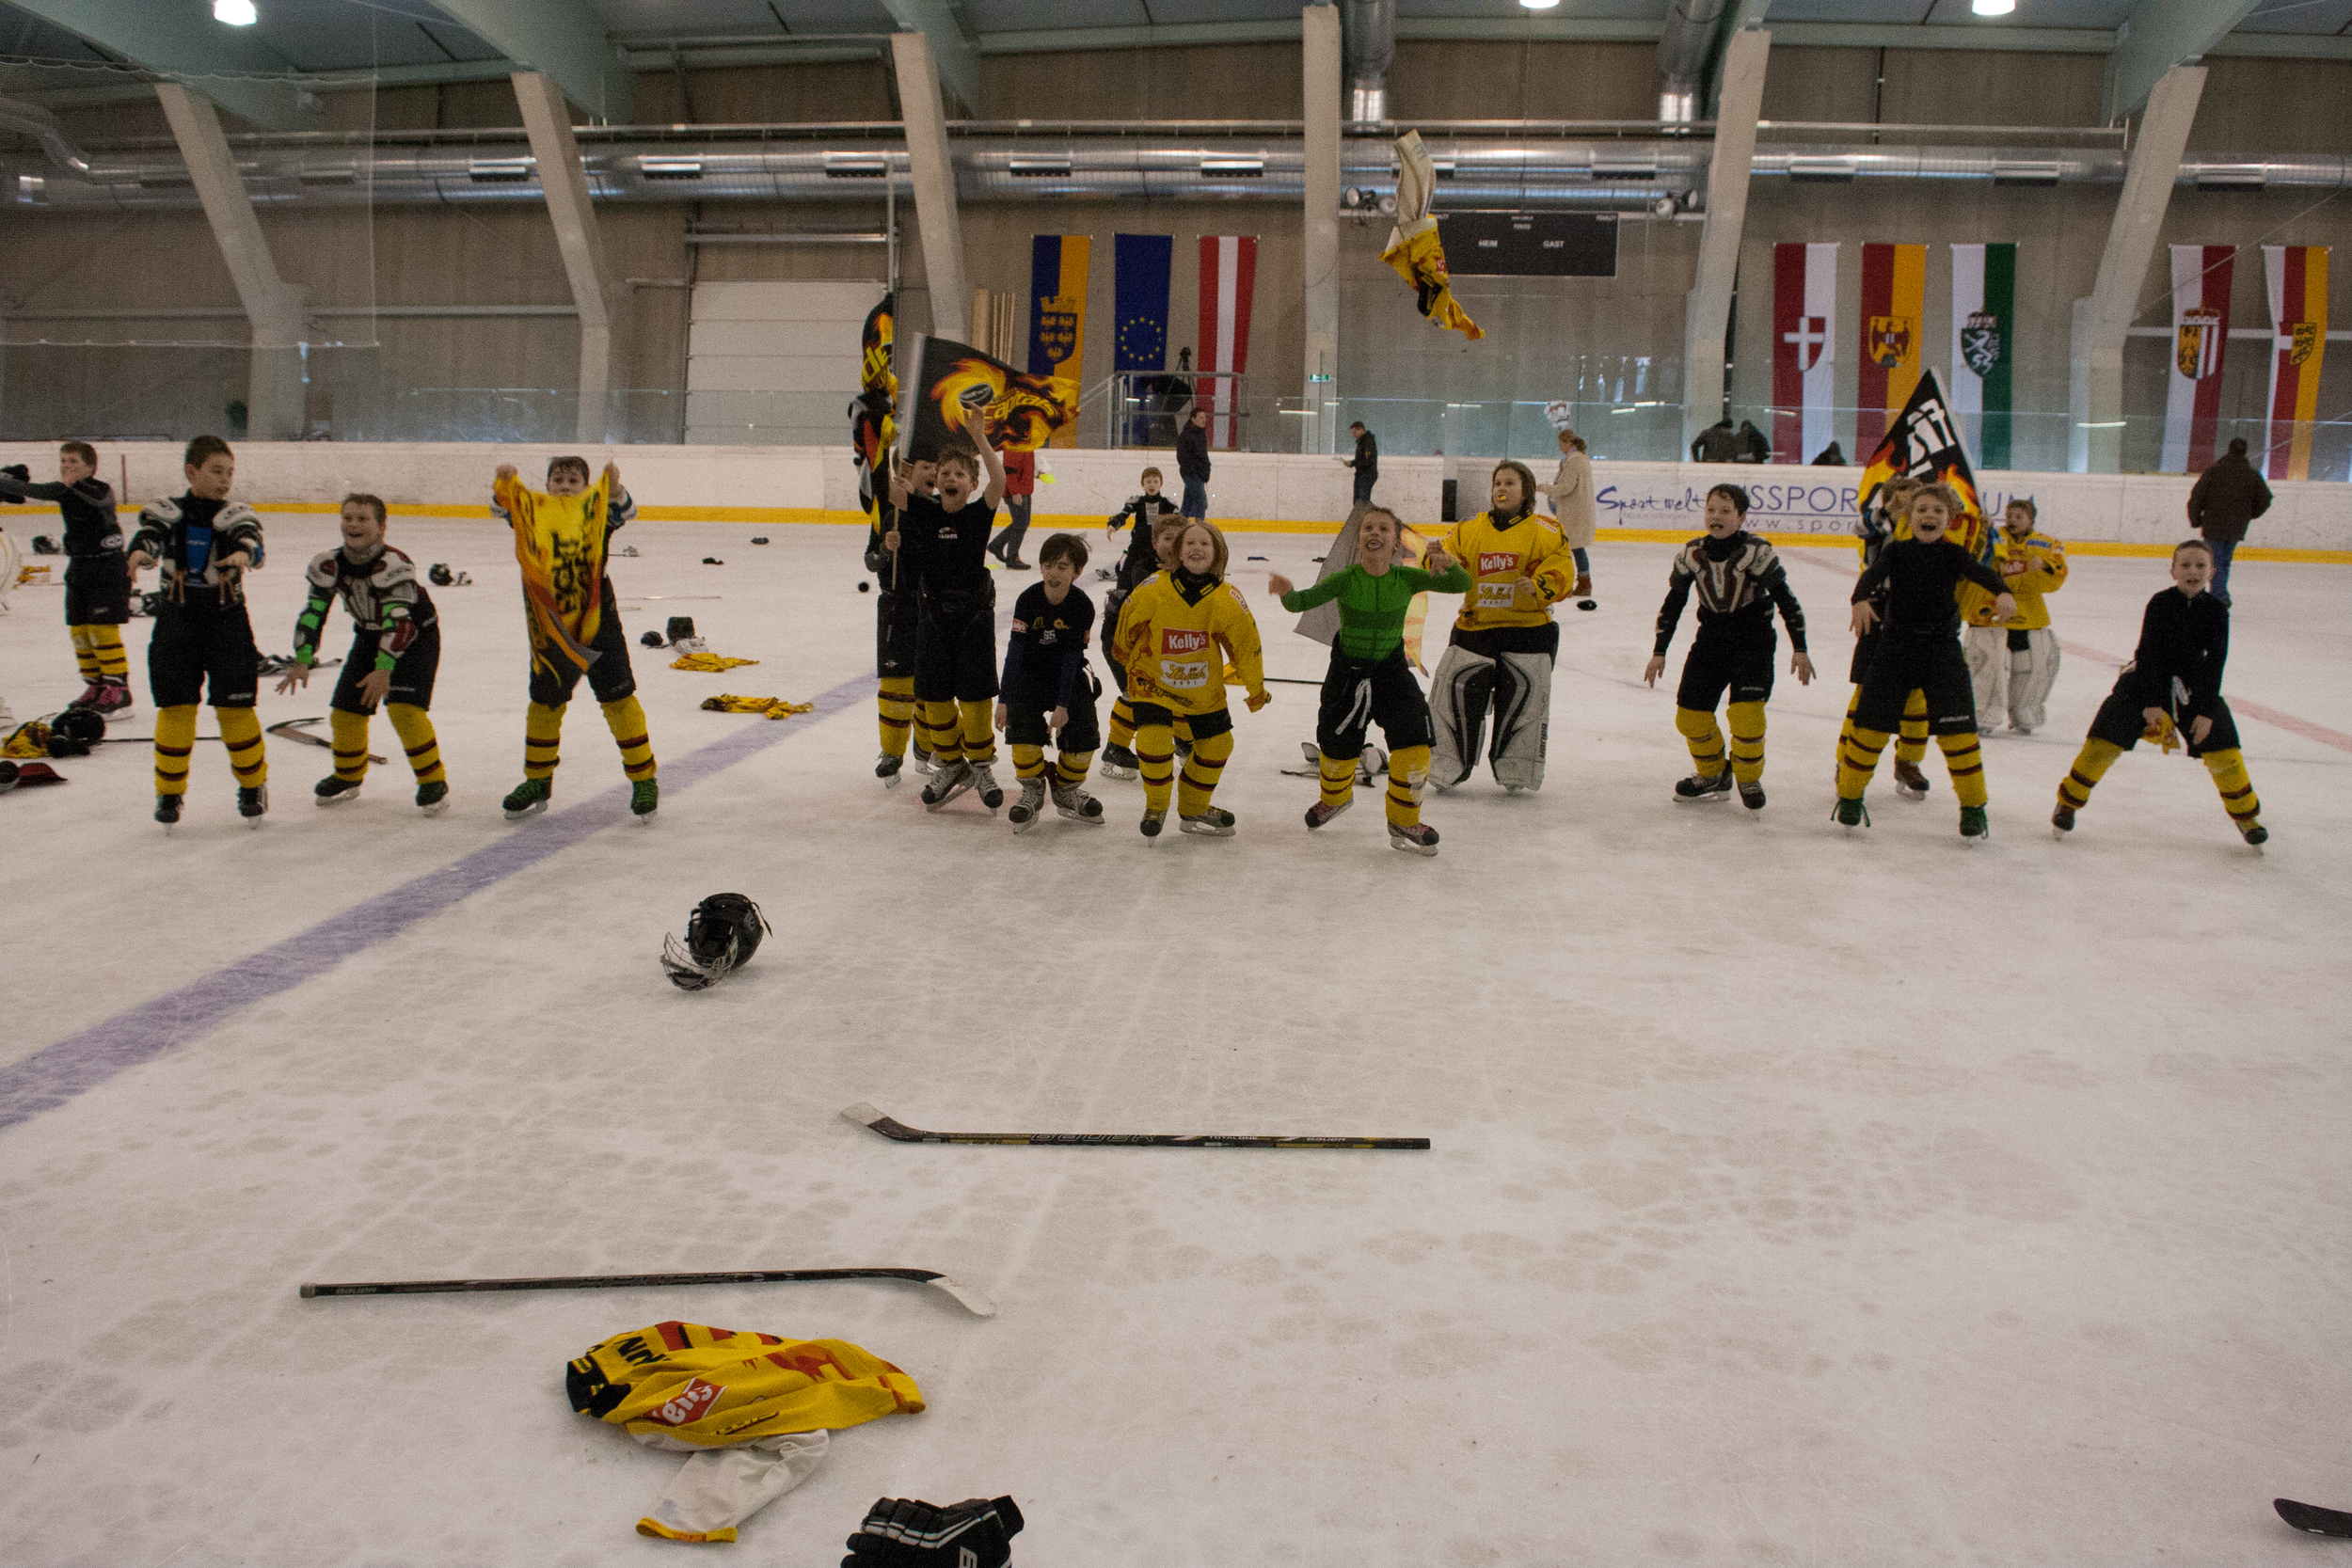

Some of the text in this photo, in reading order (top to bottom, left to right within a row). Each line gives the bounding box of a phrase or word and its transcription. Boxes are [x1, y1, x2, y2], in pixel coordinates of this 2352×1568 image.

[1542, 239, 1565, 248] GAST
[1480, 554, 1515, 571] Kelly's
[1168, 634, 1207, 651] Kelly's
